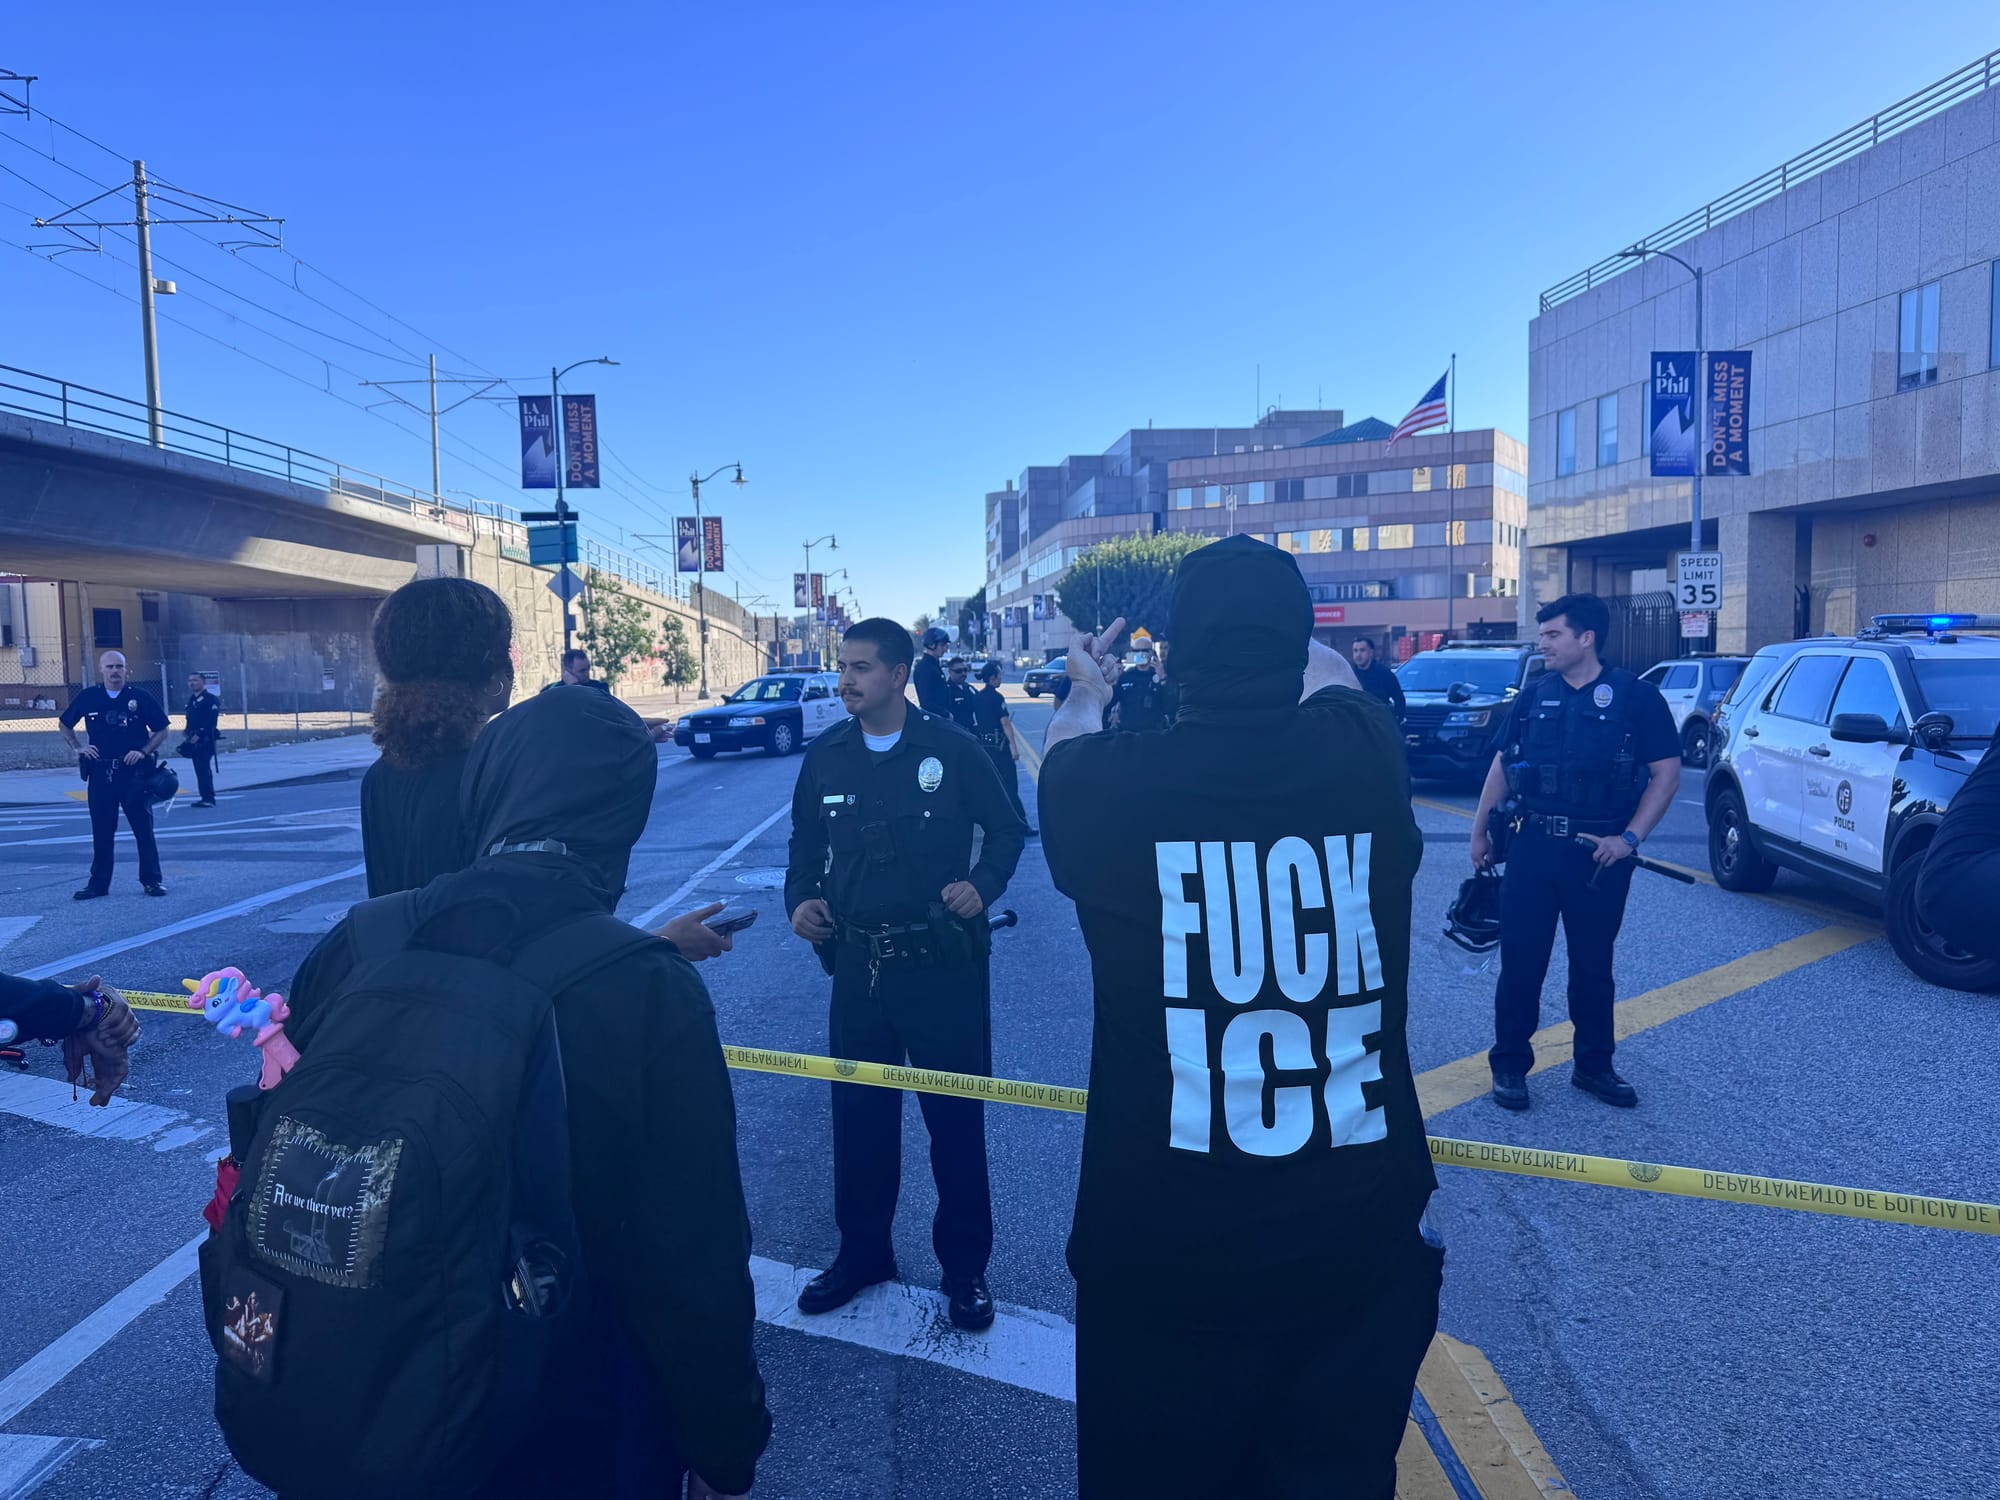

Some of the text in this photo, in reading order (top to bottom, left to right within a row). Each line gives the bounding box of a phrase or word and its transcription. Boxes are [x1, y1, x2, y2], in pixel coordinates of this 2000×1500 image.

[1656, 361, 1677, 376] LA
[1656, 376, 1689, 394] Phil
[1713, 361, 1729, 402] MISS
[523, 402, 540, 414] LA
[567, 402, 580, 433] MISS
[1729, 365, 1745, 462] A MOMENT
[524, 414, 549, 427] Phil
[580, 404, 595, 478] A MOMENT
[1680, 557, 1719, 567] SPEED
[1683, 571, 1715, 581] LIMIT
[1682, 584, 1717, 605] 35
[1834, 816, 1855, 831] POLICE
[1155, 832, 1384, 1004] FUCK
[1165, 1000, 1388, 1157] ICE
[273, 1183, 354, 1219] Are we there yet?
